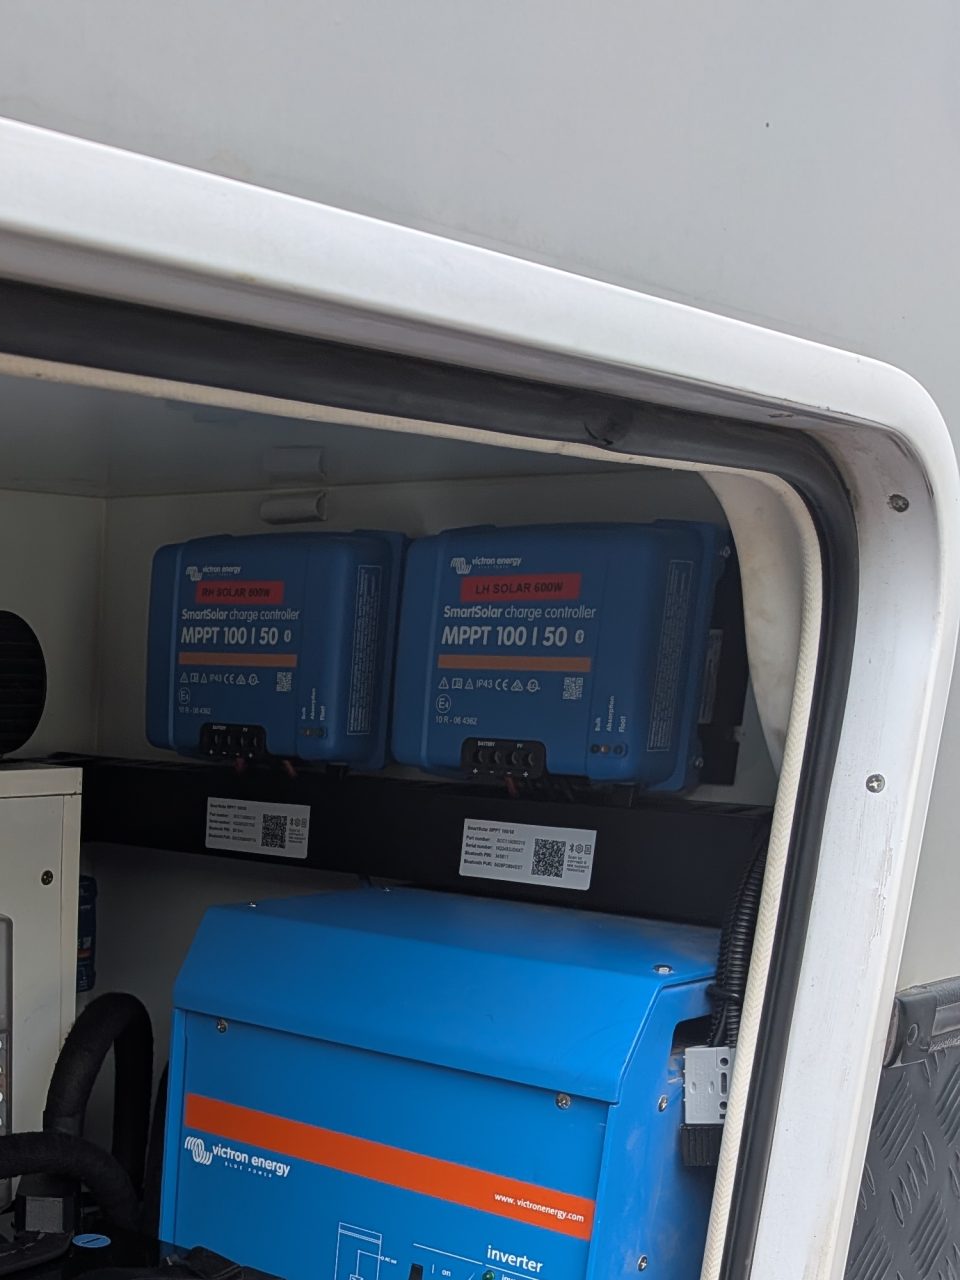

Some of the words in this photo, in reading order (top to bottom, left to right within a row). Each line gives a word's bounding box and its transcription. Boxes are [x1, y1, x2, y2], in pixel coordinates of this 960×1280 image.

[472, 556, 495, 566] victron
[497, 557, 521, 567] energy
[202, 587, 214, 597] RH
[215, 587, 246, 597] SOLAR
[475, 584, 490, 594] LH
[492, 583, 531, 594] SOLAR
[534, 582, 563, 593] 600W
[181, 608, 228, 620] SmartSolar
[229, 608, 258, 623] charge
[260, 608, 300, 620] controller
[443, 605, 503, 618] SmartSolar
[505, 605, 542, 621] charge
[544, 605, 596, 618] controller
[181, 627, 220, 644] MPPT
[223, 627, 247, 644] 100
[259, 628, 278, 645] 50
[441, 625, 492, 645] MPPT
[496, 626, 527, 645] 100
[542, 627, 567, 646] 50
[212, 1144, 248, 1164] victron
[251, 1155, 290, 1177] energy
[487, 1245, 543, 1273] inverter
[441, 1269, 451, 1277] on
